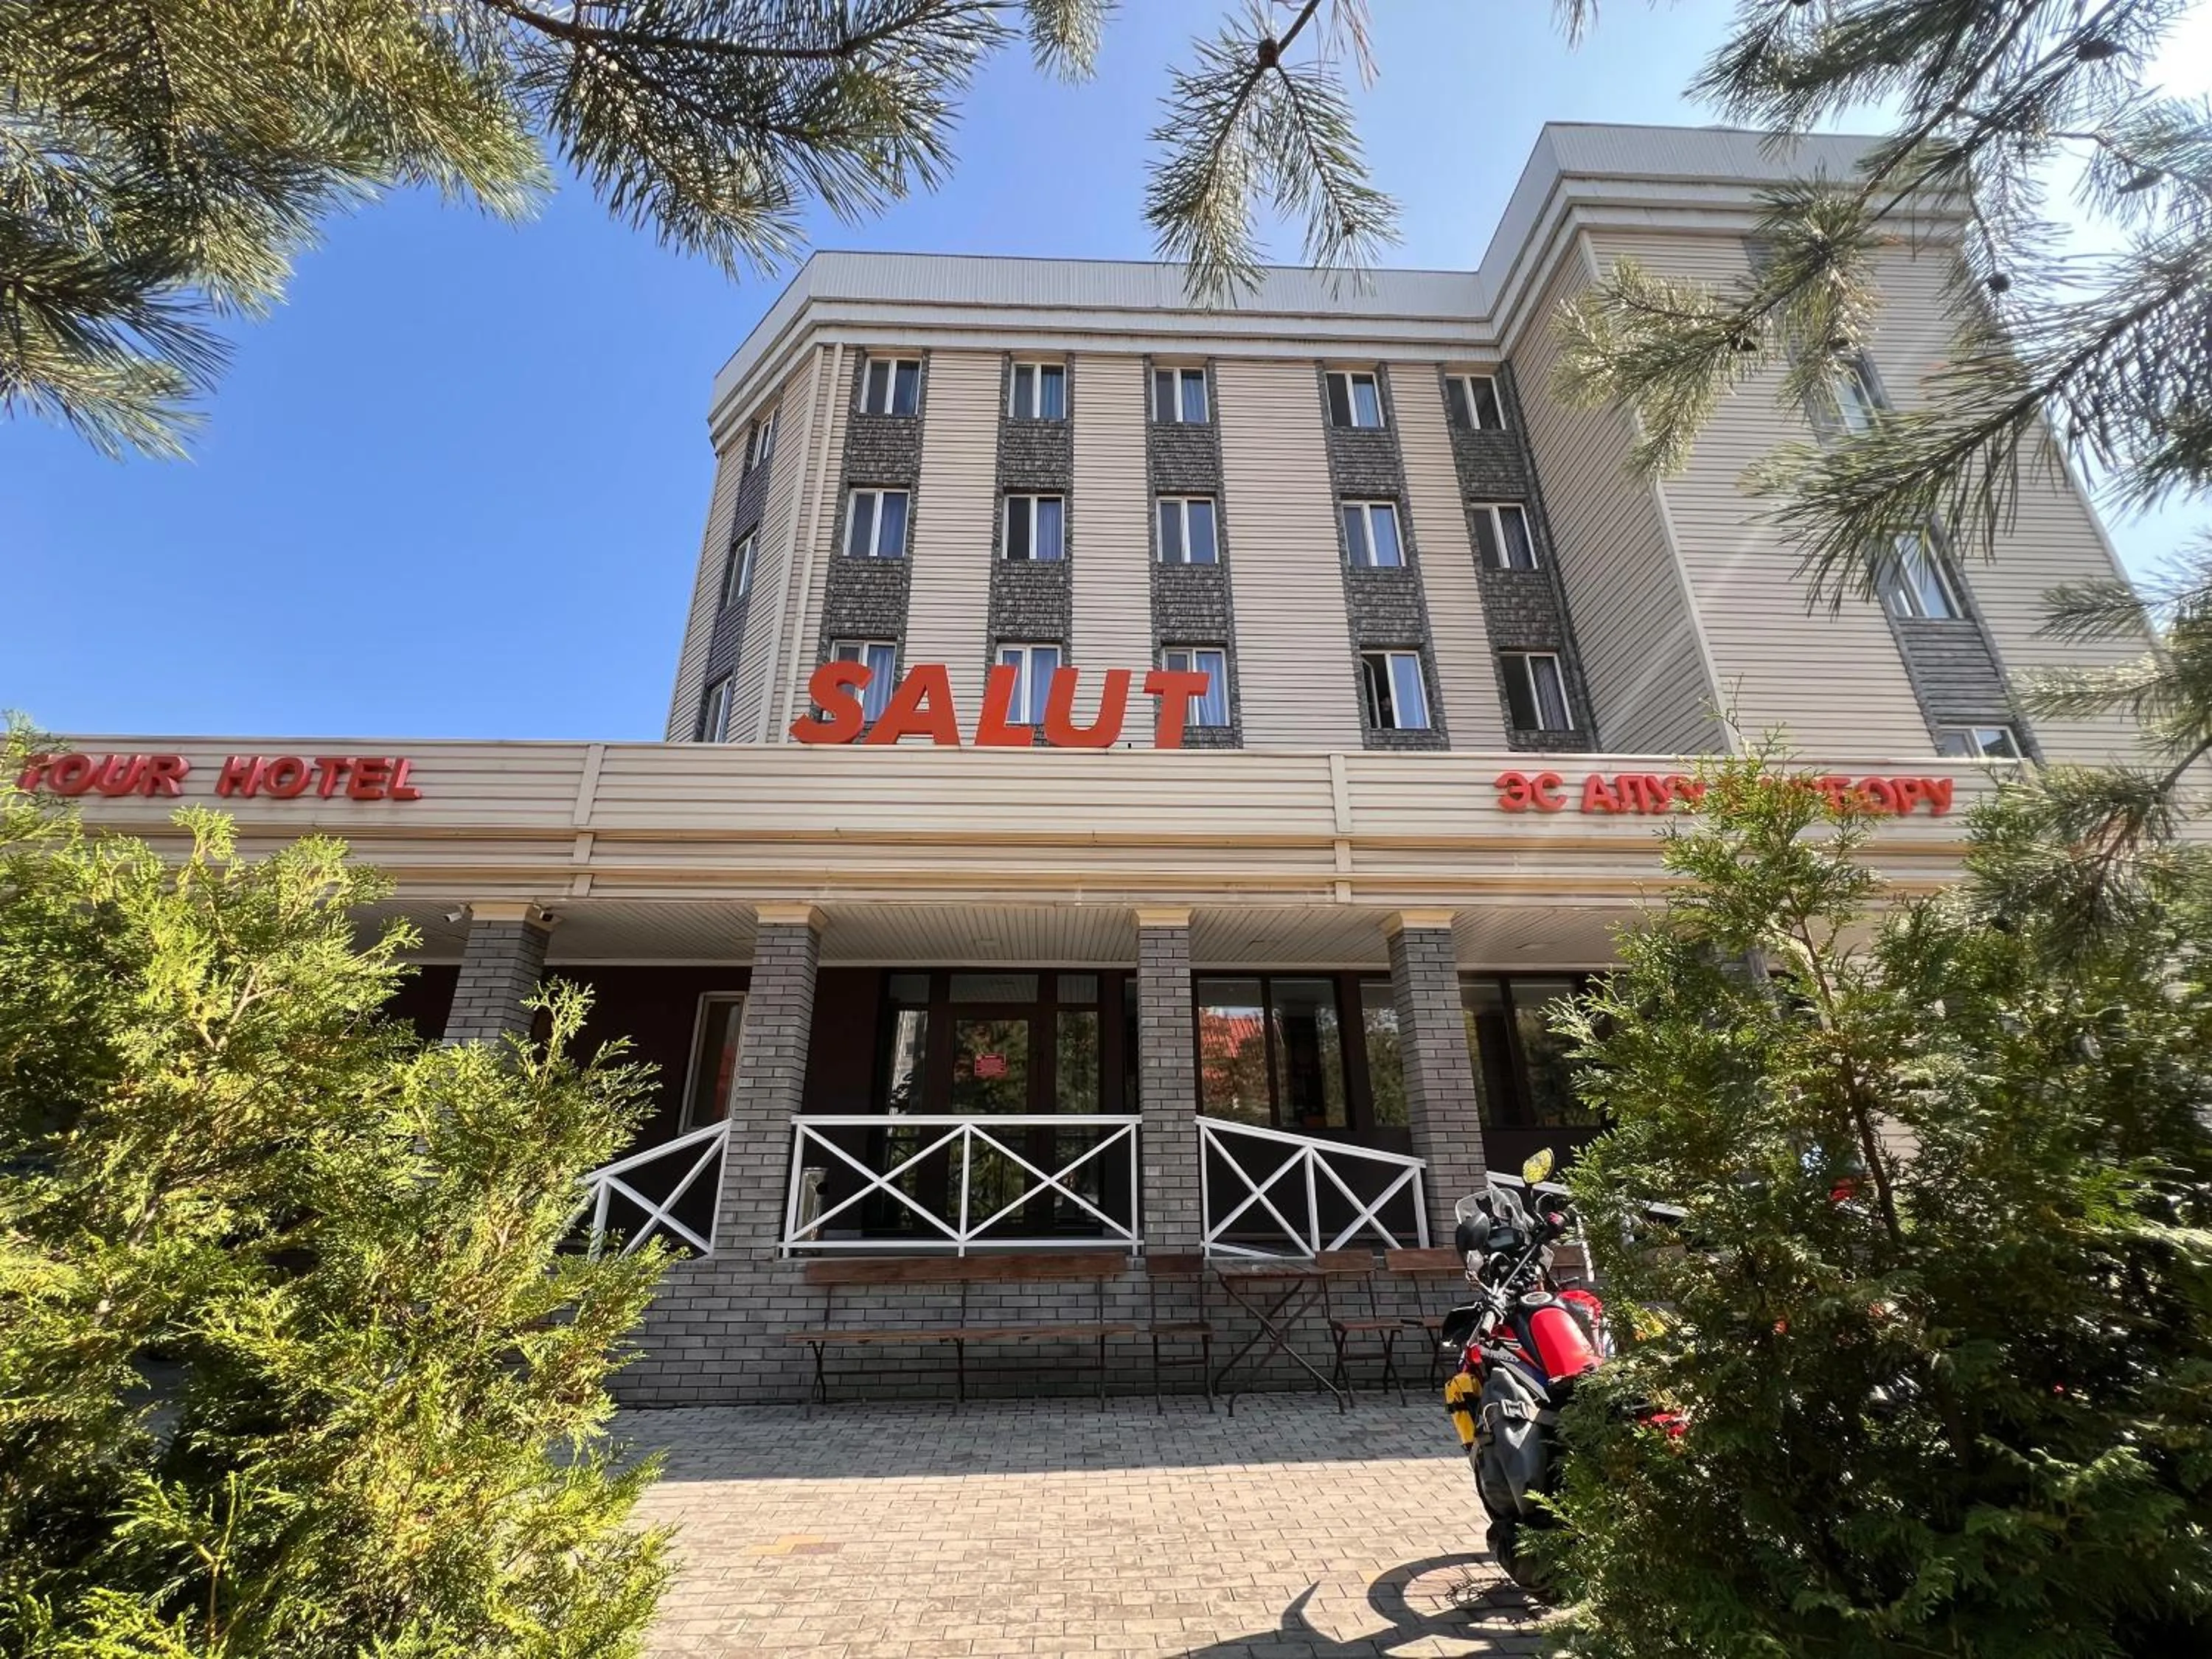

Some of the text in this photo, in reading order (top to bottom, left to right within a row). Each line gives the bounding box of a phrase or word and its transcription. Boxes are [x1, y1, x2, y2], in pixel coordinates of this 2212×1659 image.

[789, 660, 1209, 749] SALUT
[16, 753, 422, 800] TOUR HOTEL
[1494, 771, 1568, 813] ЭС
